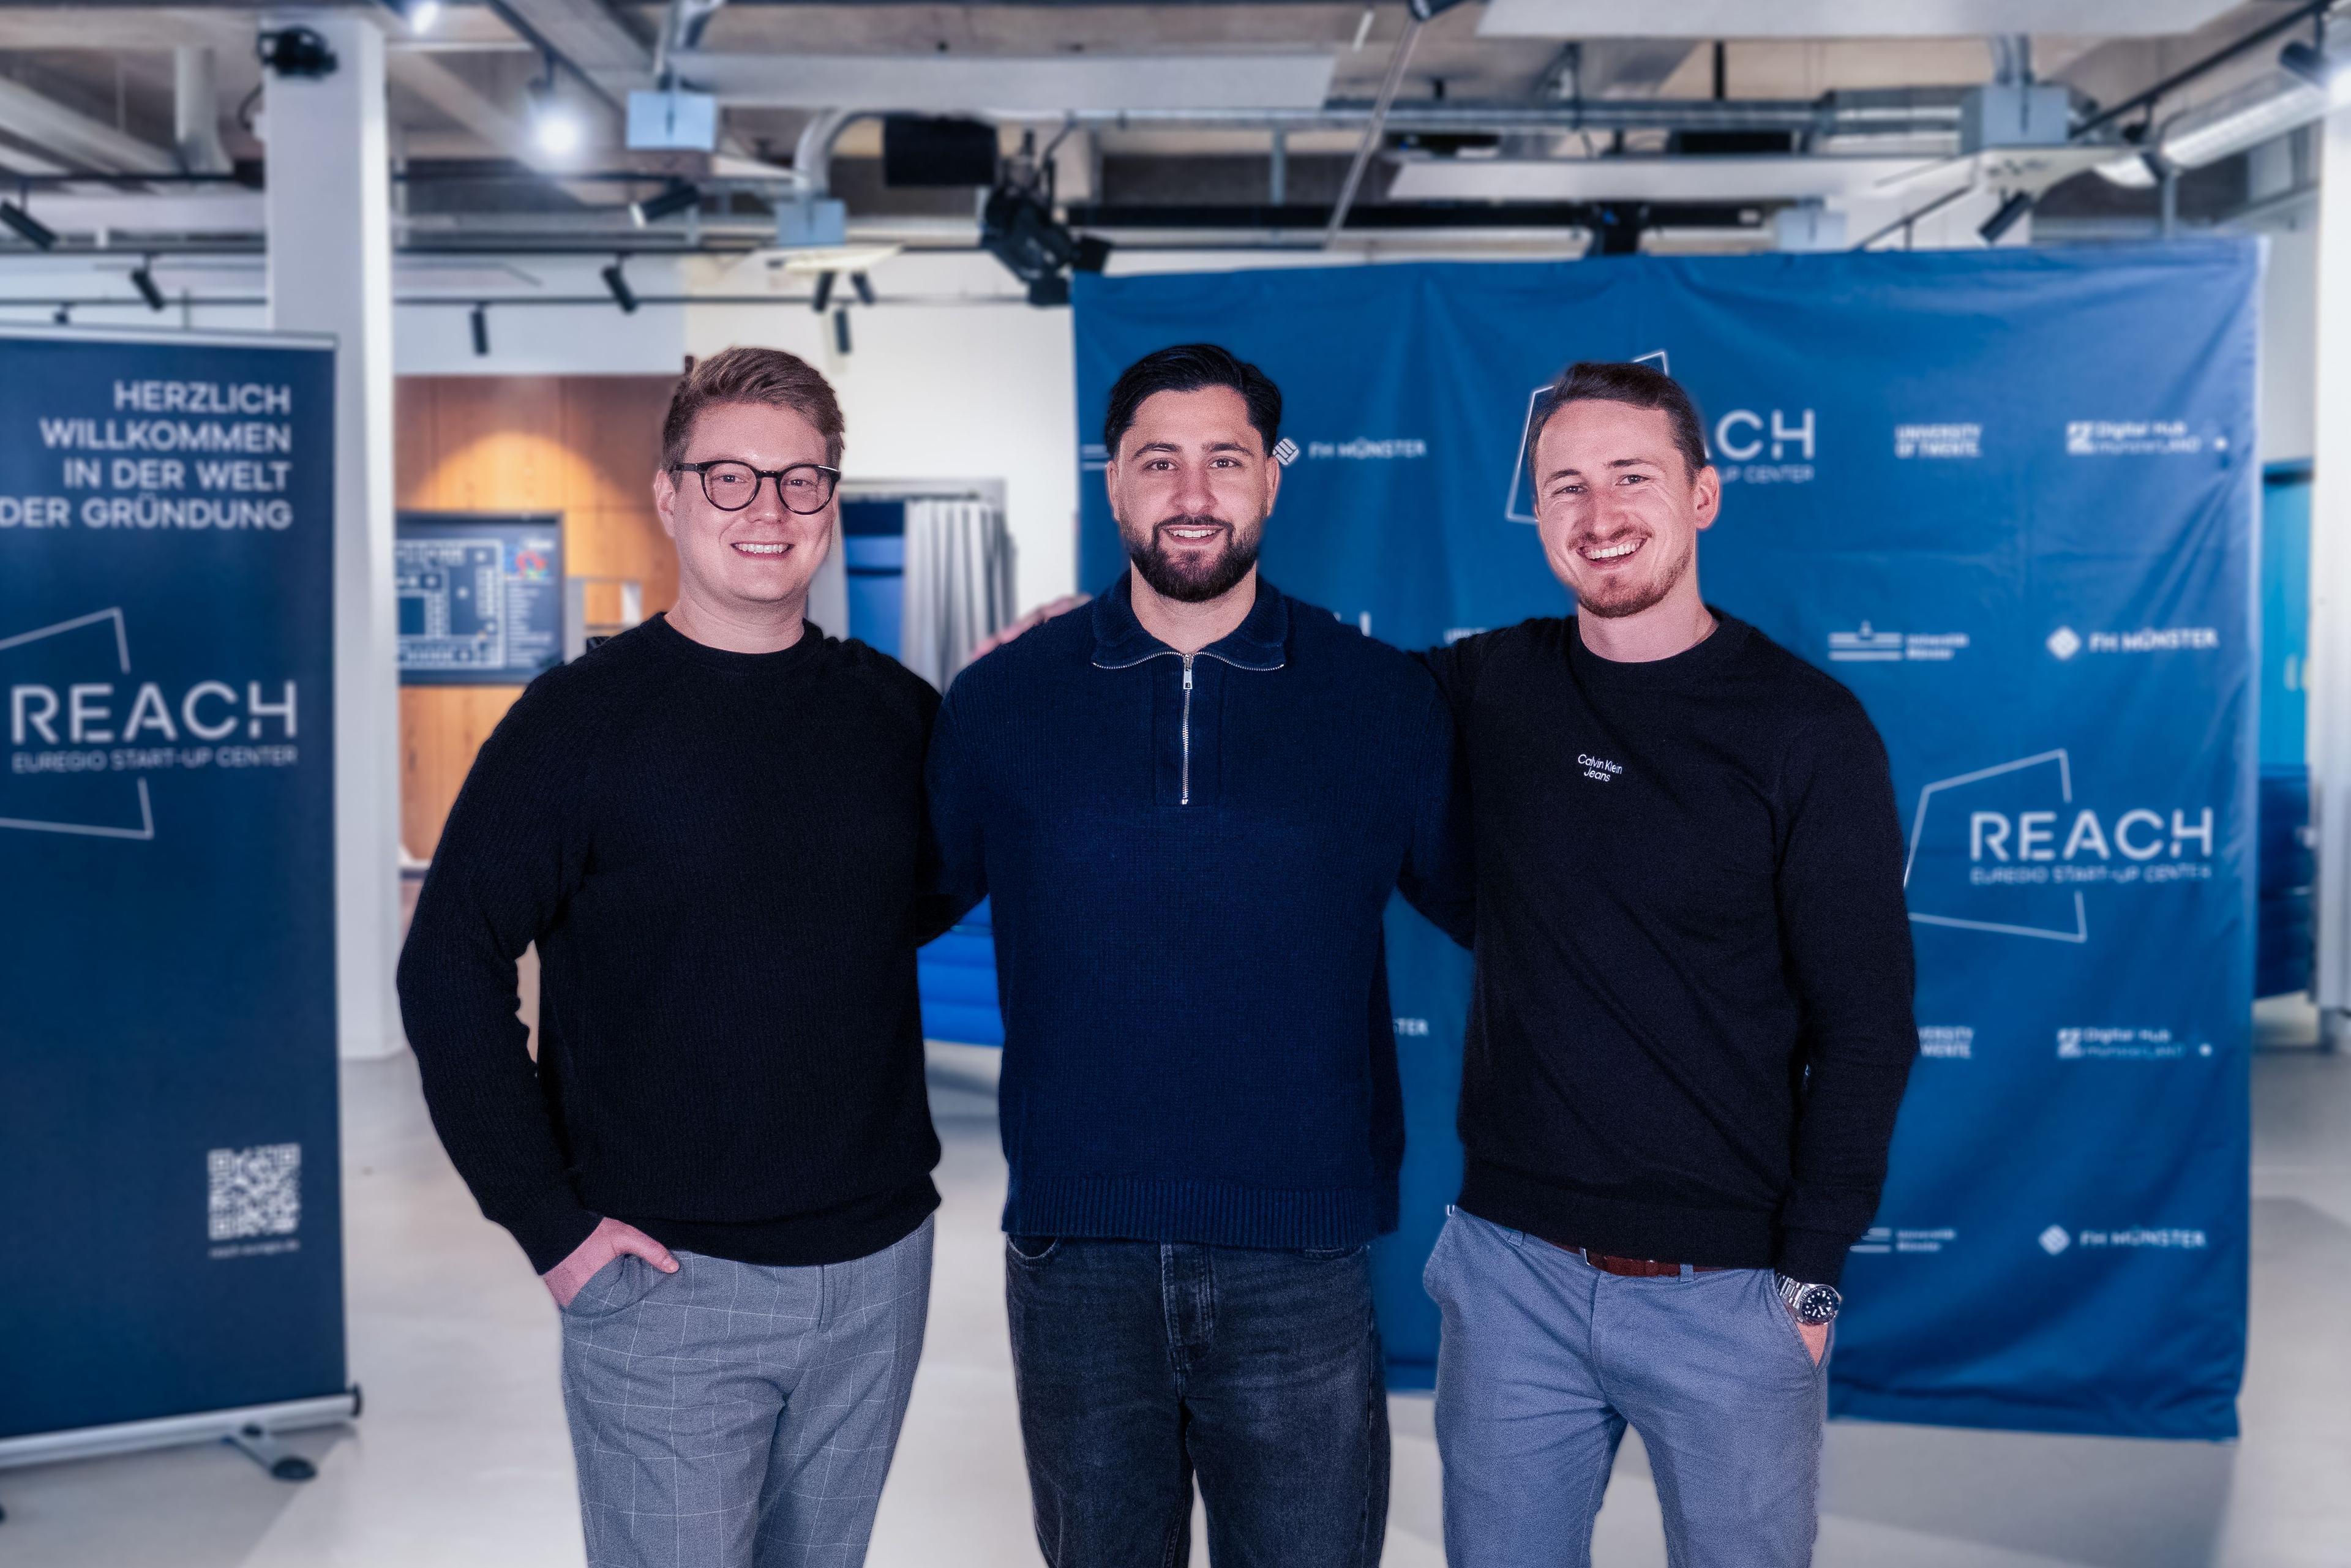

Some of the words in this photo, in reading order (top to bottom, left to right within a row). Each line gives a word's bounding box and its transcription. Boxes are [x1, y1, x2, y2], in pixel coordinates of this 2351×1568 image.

[114, 380, 291, 415] HERZLICH
[39, 417, 292, 453] WILLKOMMEN
[1309, 441, 1335, 459] FH
[1337, 437, 1427, 459] MÜNSTER
[64, 457, 101, 489] IN
[111, 458, 185, 490] DER
[195, 460, 291, 492] WELT
[0, 496, 70, 528] DER
[81, 492, 293, 530] GRÜNDUNG
[2088, 631, 2118, 653] FH
[2121, 626, 2219, 651] MÜNSTER
[12, 681, 298, 744] REACH
[12, 750, 108, 774] EUREGIO
[110, 746, 212, 771] START-UP
[216, 744, 299, 768] CENTER
[1578, 754, 1604, 769] Calvin
[1604, 760, 1622, 775] Klein
[1583, 767, 1611, 782] Jeans
[1971, 806, 2213, 861] REACH
[2080, 1230, 2107, 1247] FH
